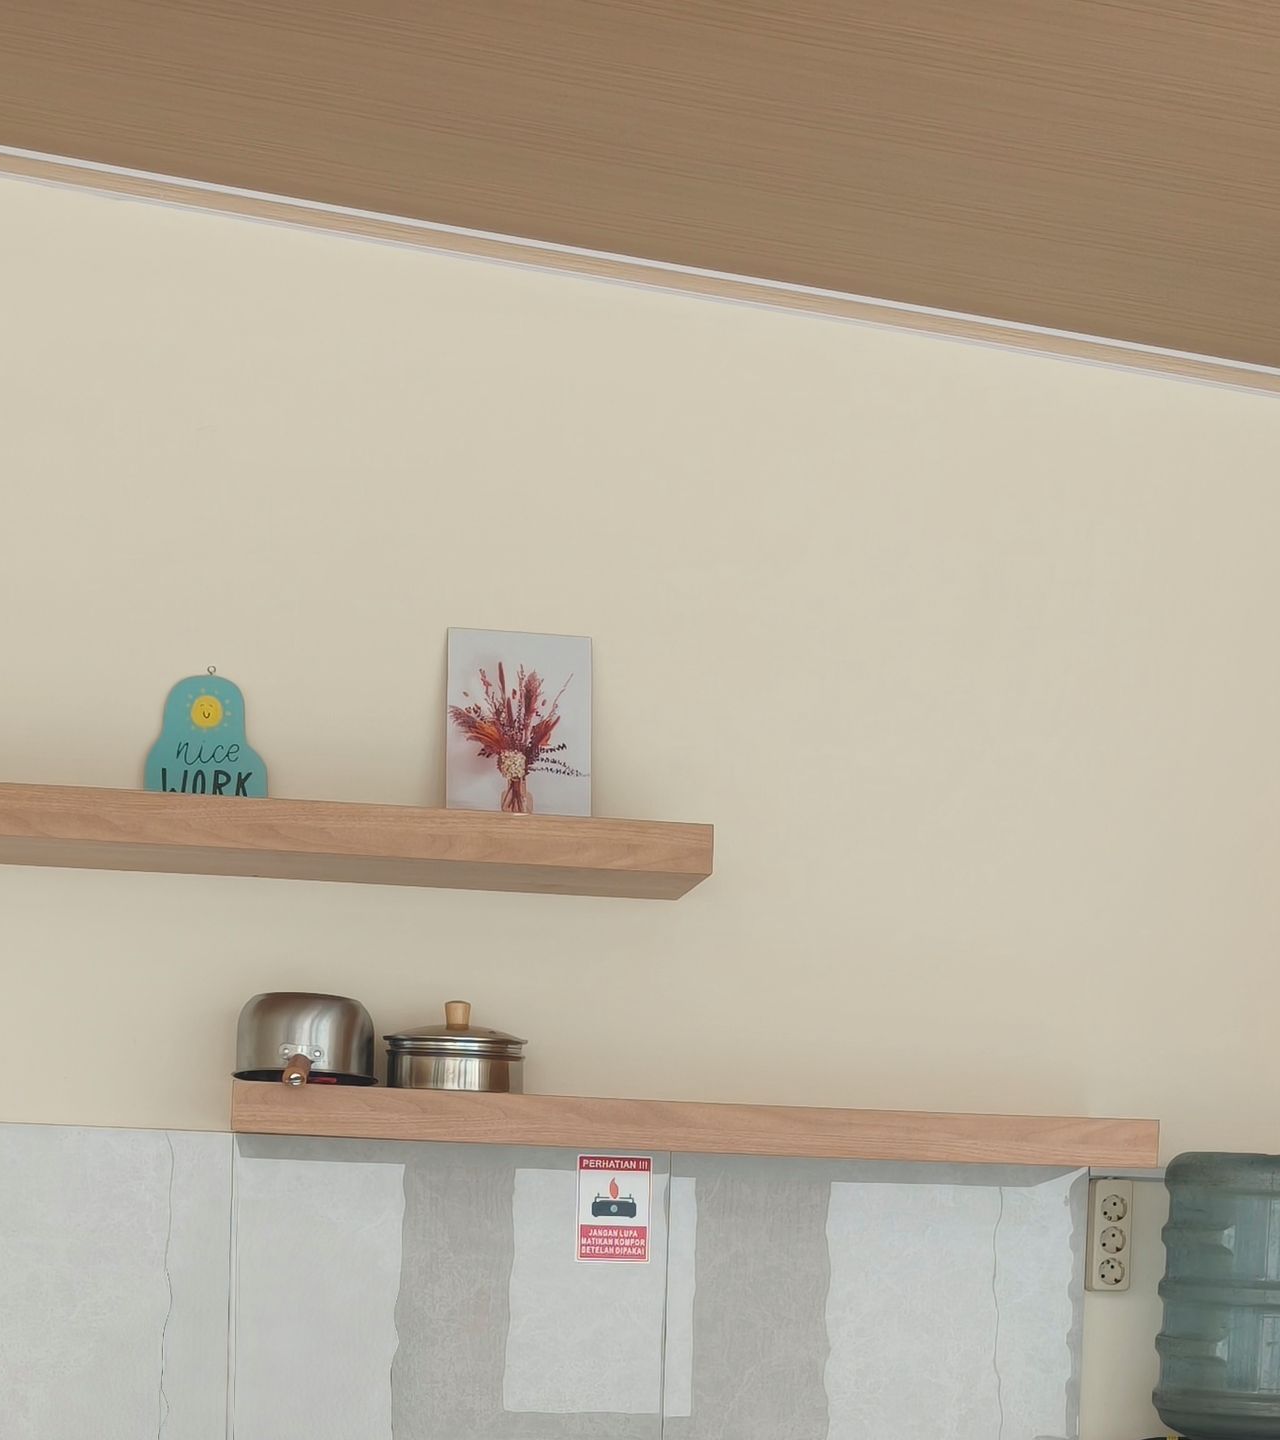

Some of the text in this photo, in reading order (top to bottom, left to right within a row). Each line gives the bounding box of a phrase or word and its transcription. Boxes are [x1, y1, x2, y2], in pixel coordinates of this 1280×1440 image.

[176, 740, 240, 766] nice
[160, 767, 253, 797] WORK
[582, 1159, 637, 1169] PERHATIAN
[588, 1228, 617, 1237] JANGAN
[614, 1238, 646, 1247] KOMPOR
